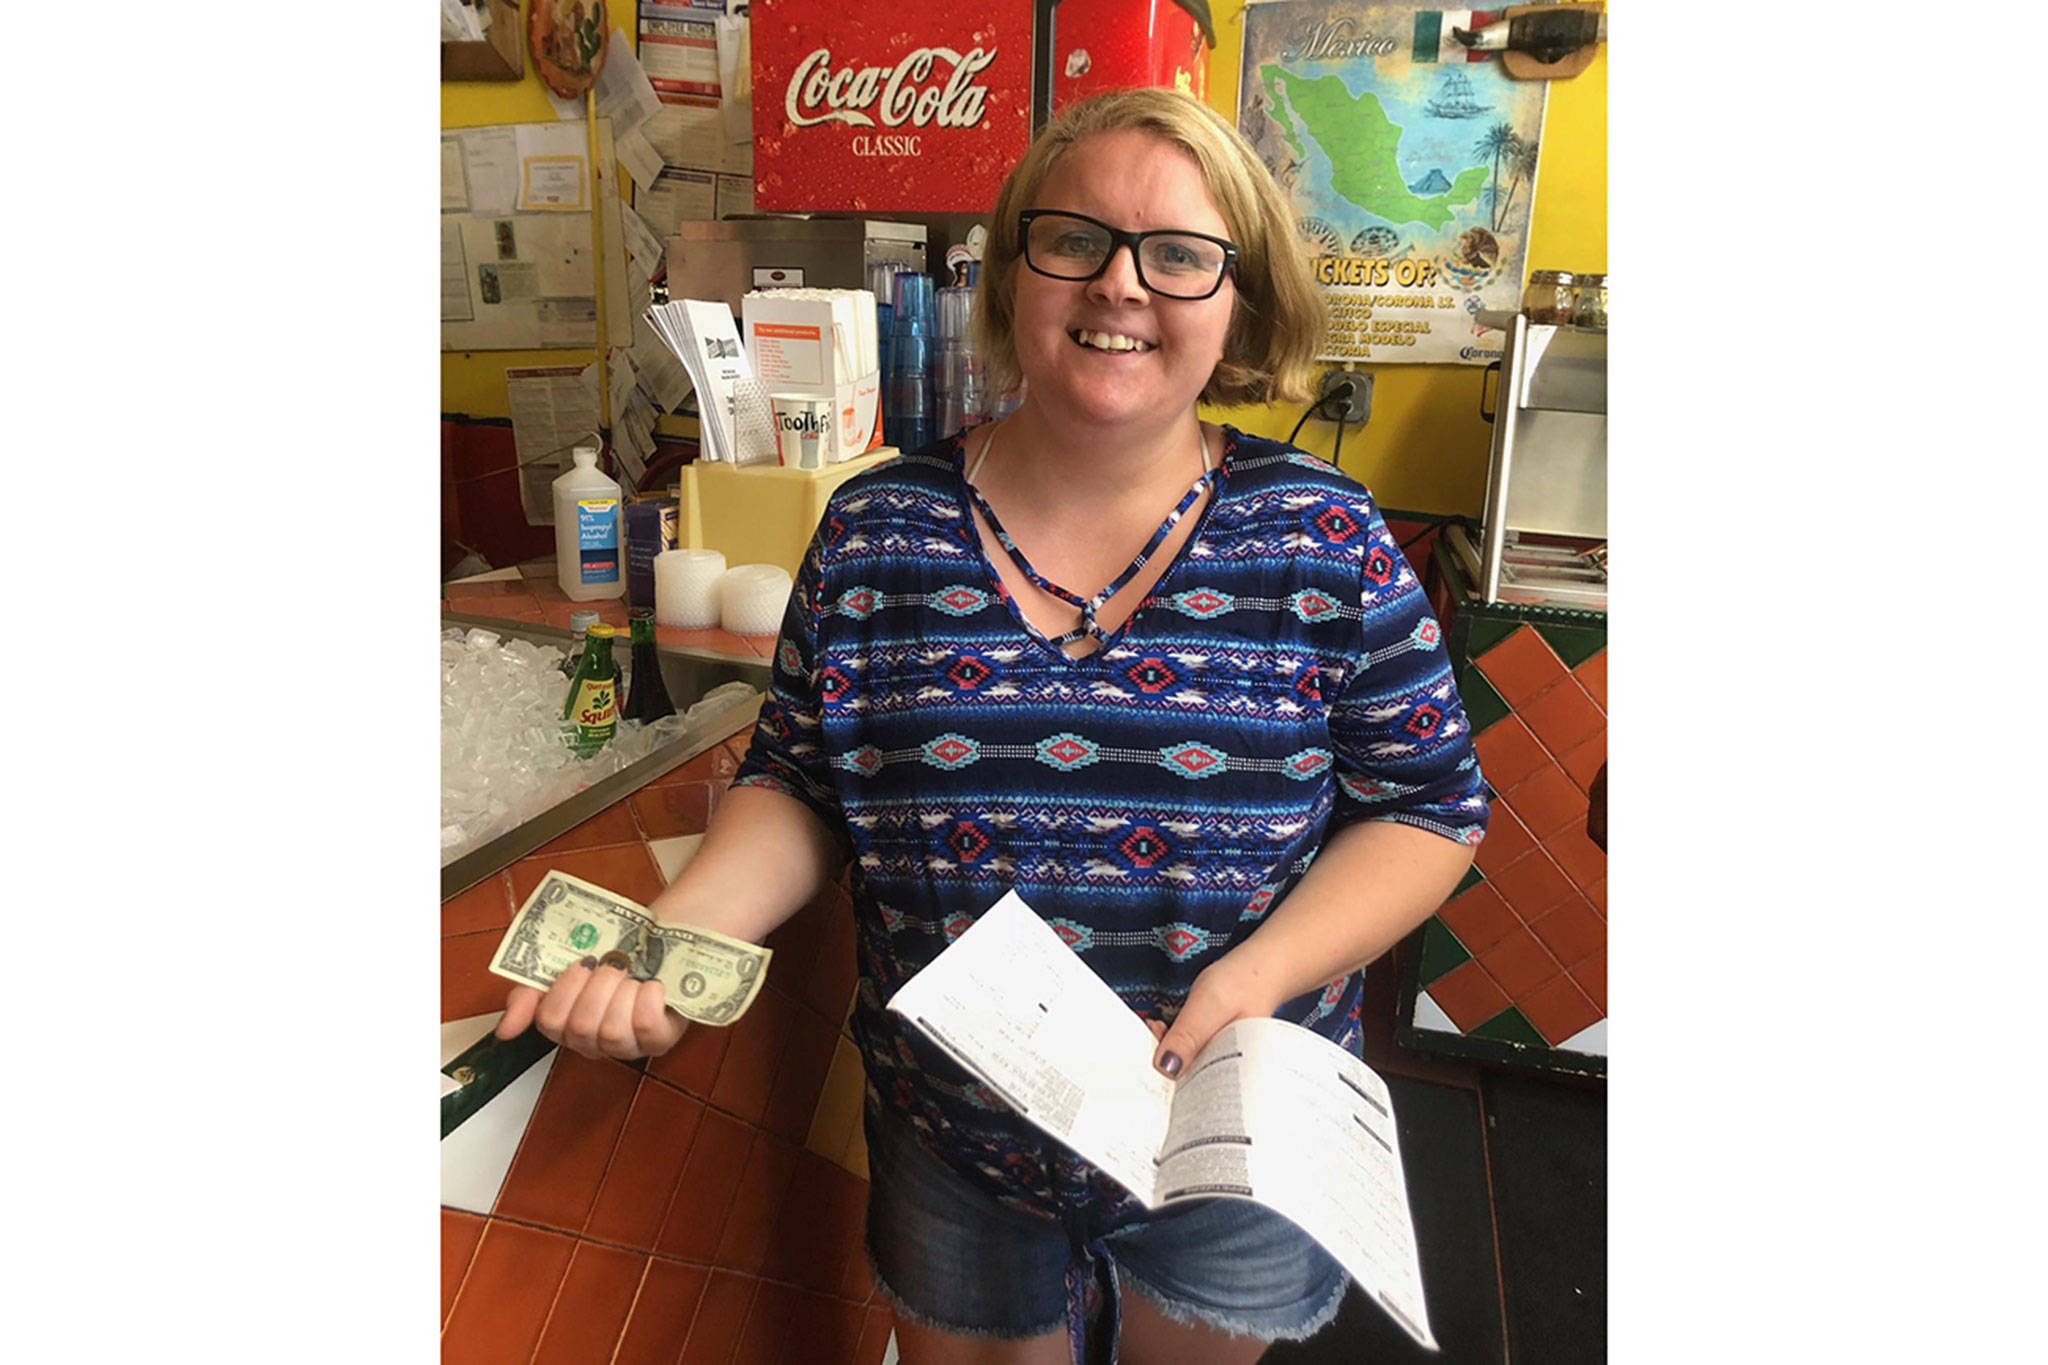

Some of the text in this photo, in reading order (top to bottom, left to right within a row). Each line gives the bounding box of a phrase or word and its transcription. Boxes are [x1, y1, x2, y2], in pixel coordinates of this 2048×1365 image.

[1281, 16, 1395, 62] Mexico
[785, 47, 998, 127] Coca-Cola
[852, 136, 922, 157] CLASSIC
[1396, 258, 1437, 288] OF:
[1327, 307, 1373, 320] CIFICO
[1370, 321, 1432, 335] ESPECIAL
[1359, 334, 1417, 347] MODELO
